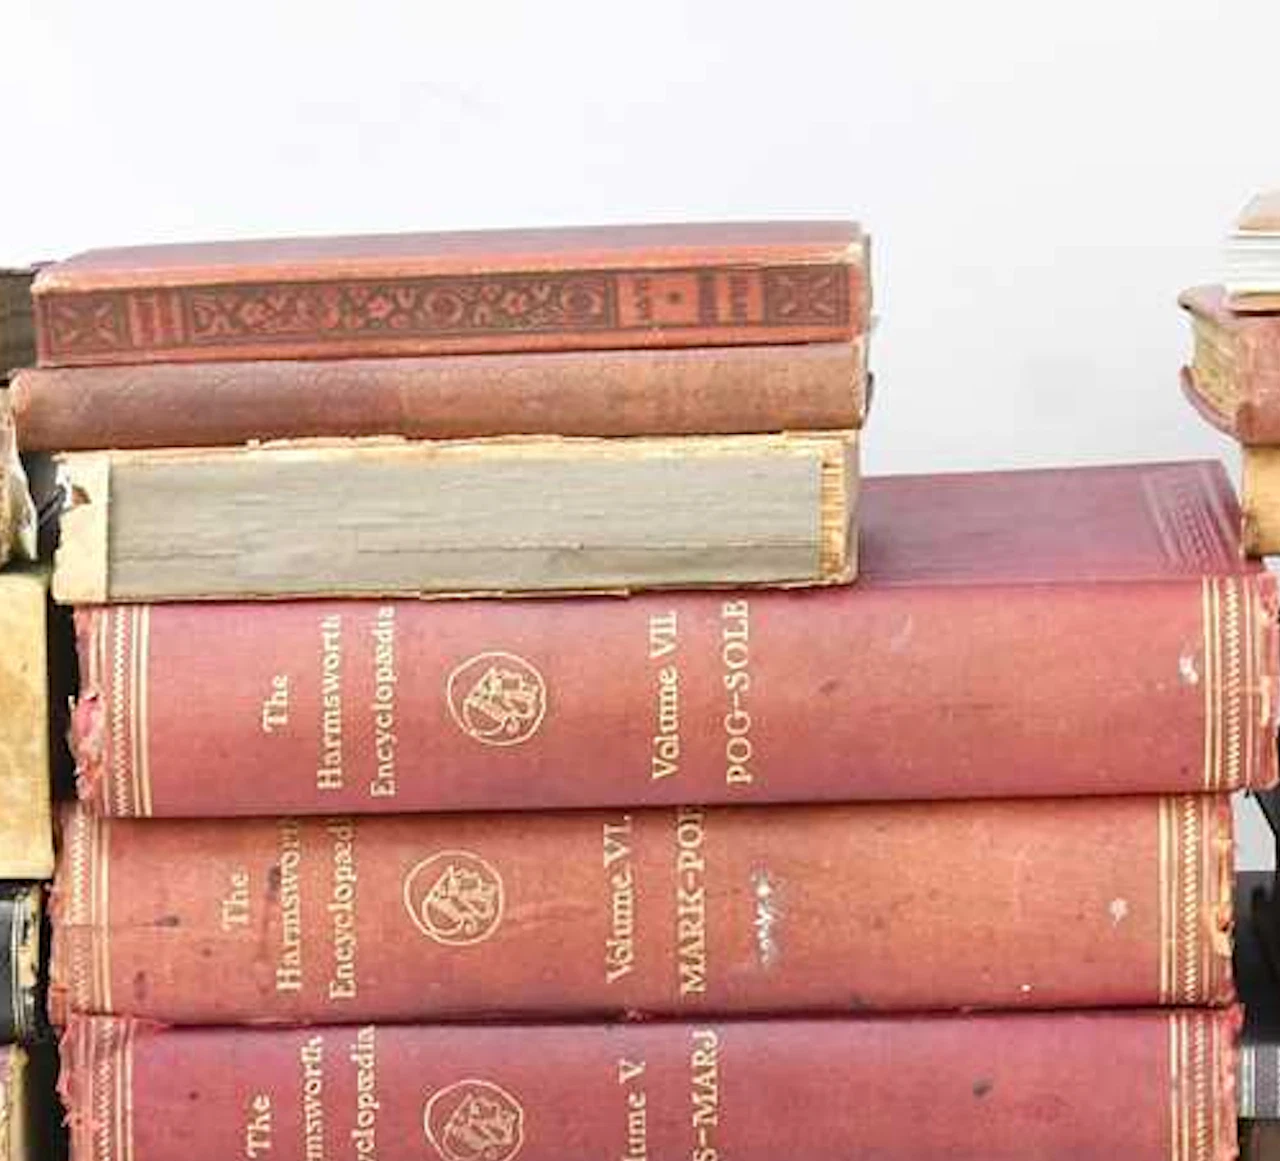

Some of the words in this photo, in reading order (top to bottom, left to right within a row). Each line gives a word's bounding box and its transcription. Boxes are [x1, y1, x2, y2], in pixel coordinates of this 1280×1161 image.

[261, 674, 290, 734] The
[315, 613, 343, 791] Harmsworth
[650, 664, 680, 780] Volume
[220, 871, 251, 933] The
[604, 861, 635, 984] Volume
[246, 1094, 273, 1159] The
